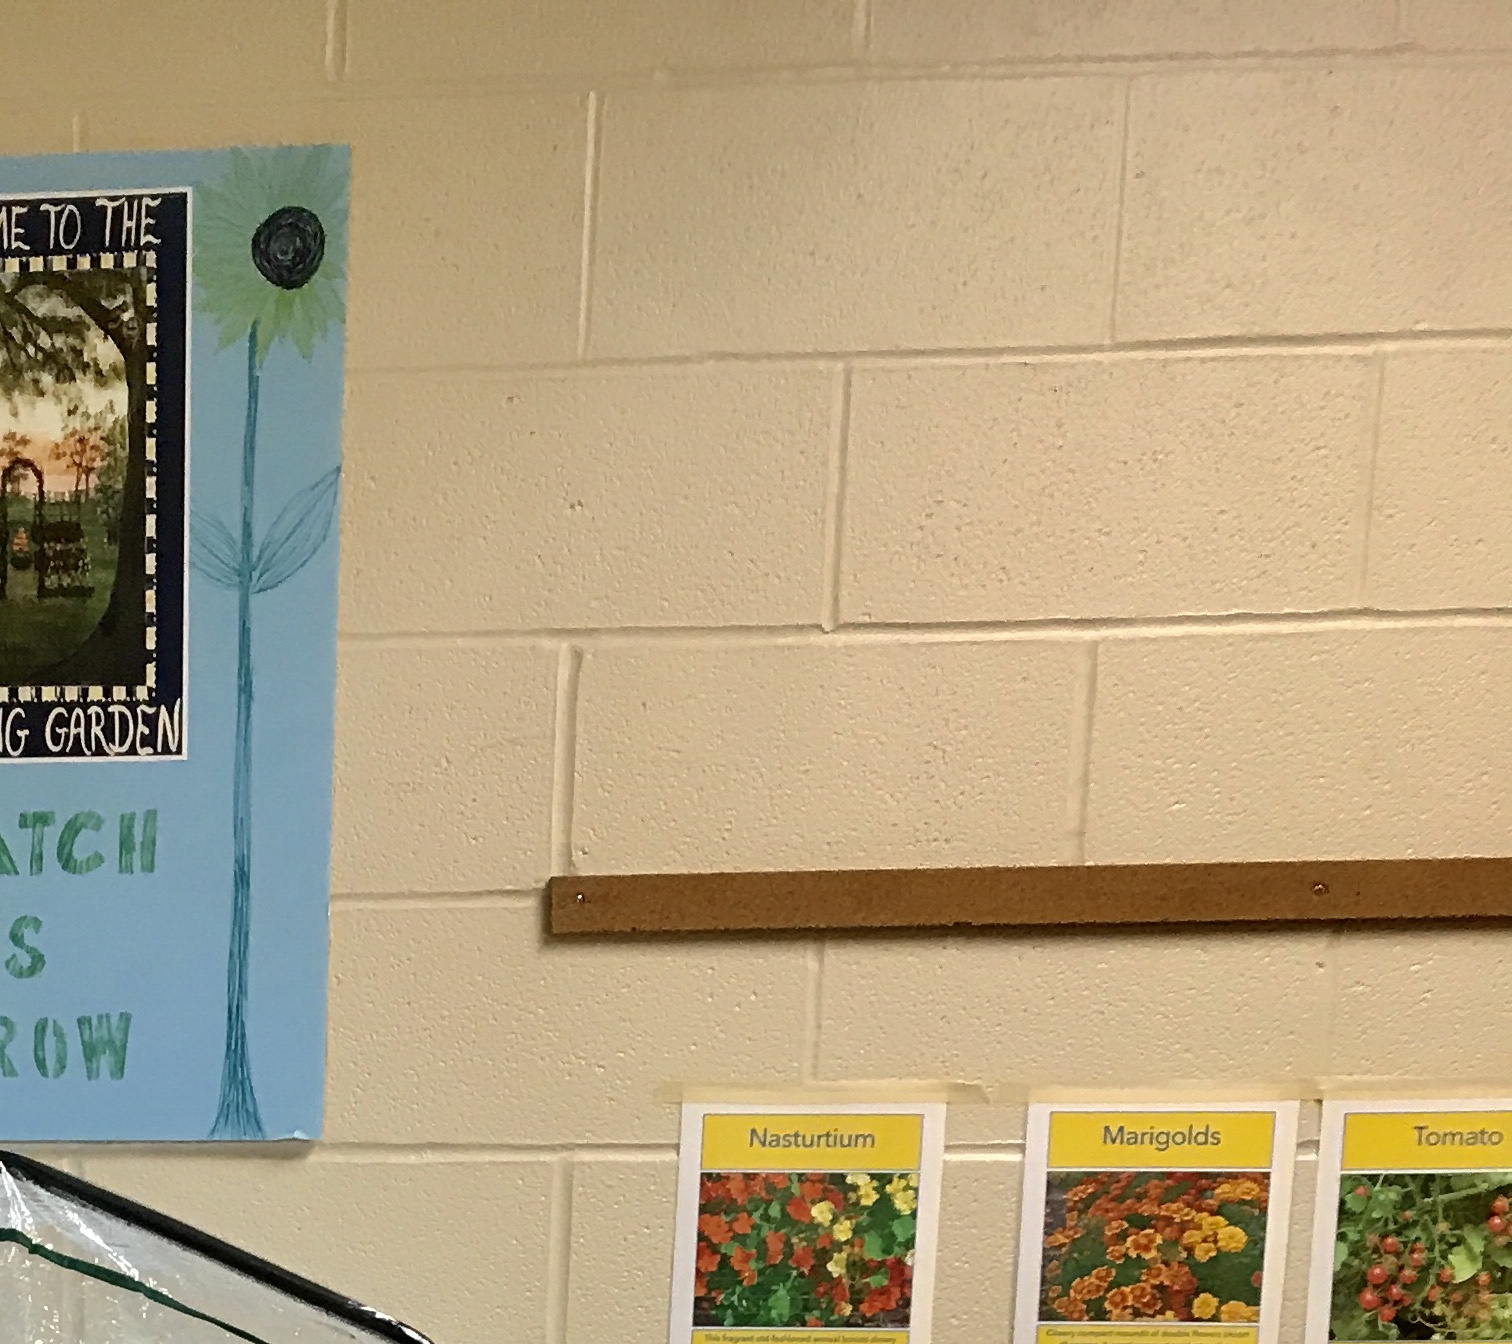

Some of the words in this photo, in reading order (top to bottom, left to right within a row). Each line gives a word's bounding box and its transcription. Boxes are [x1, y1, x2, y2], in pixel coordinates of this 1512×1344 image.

[39, 203, 83, 250] TO
[95, 197, 162, 248] THE
[45, 697, 182, 757] GARDEN
[748, 1127, 876, 1149] Nasturtium
[1102, 1124, 1221, 1152] Marigolds
[1413, 1125, 1504, 1147] Tomato
